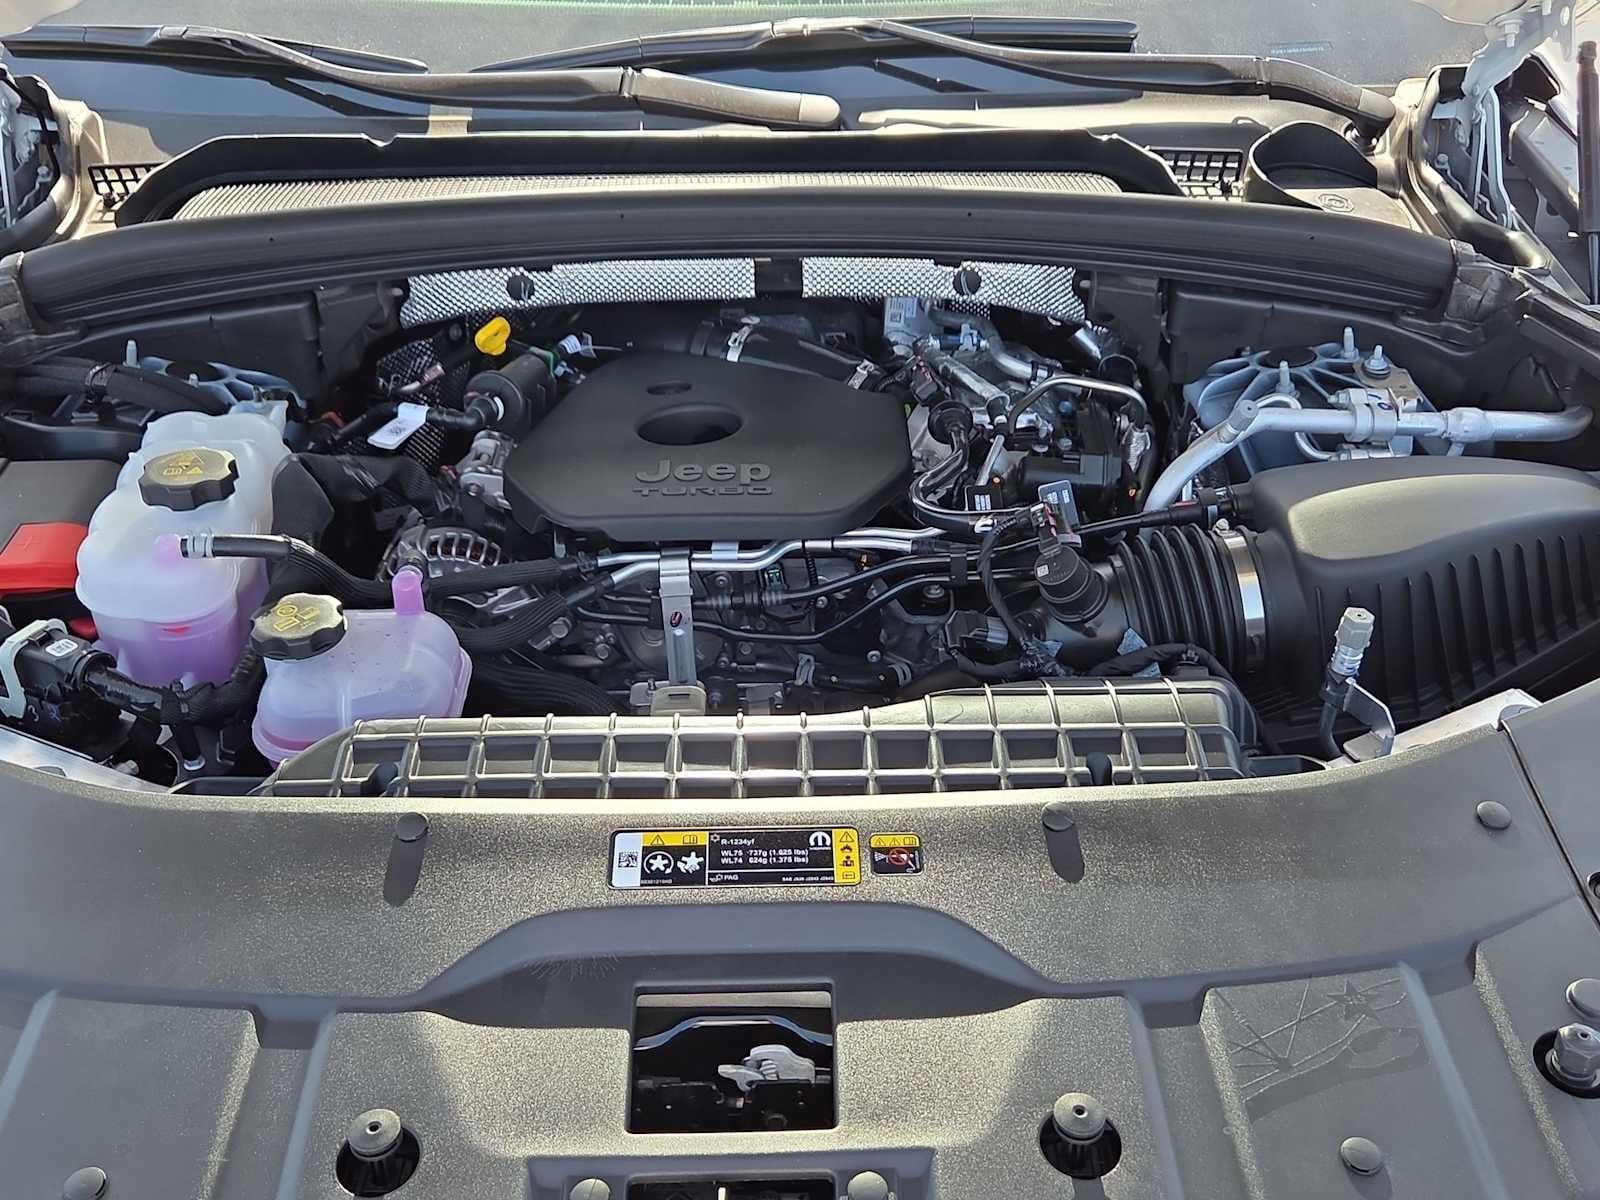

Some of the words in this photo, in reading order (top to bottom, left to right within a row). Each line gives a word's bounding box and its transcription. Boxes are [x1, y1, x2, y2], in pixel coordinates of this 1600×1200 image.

[635, 459, 772, 486] Jeep
[632, 486, 773, 497] TURBO
[721, 838, 755, 846] R-1234yf
